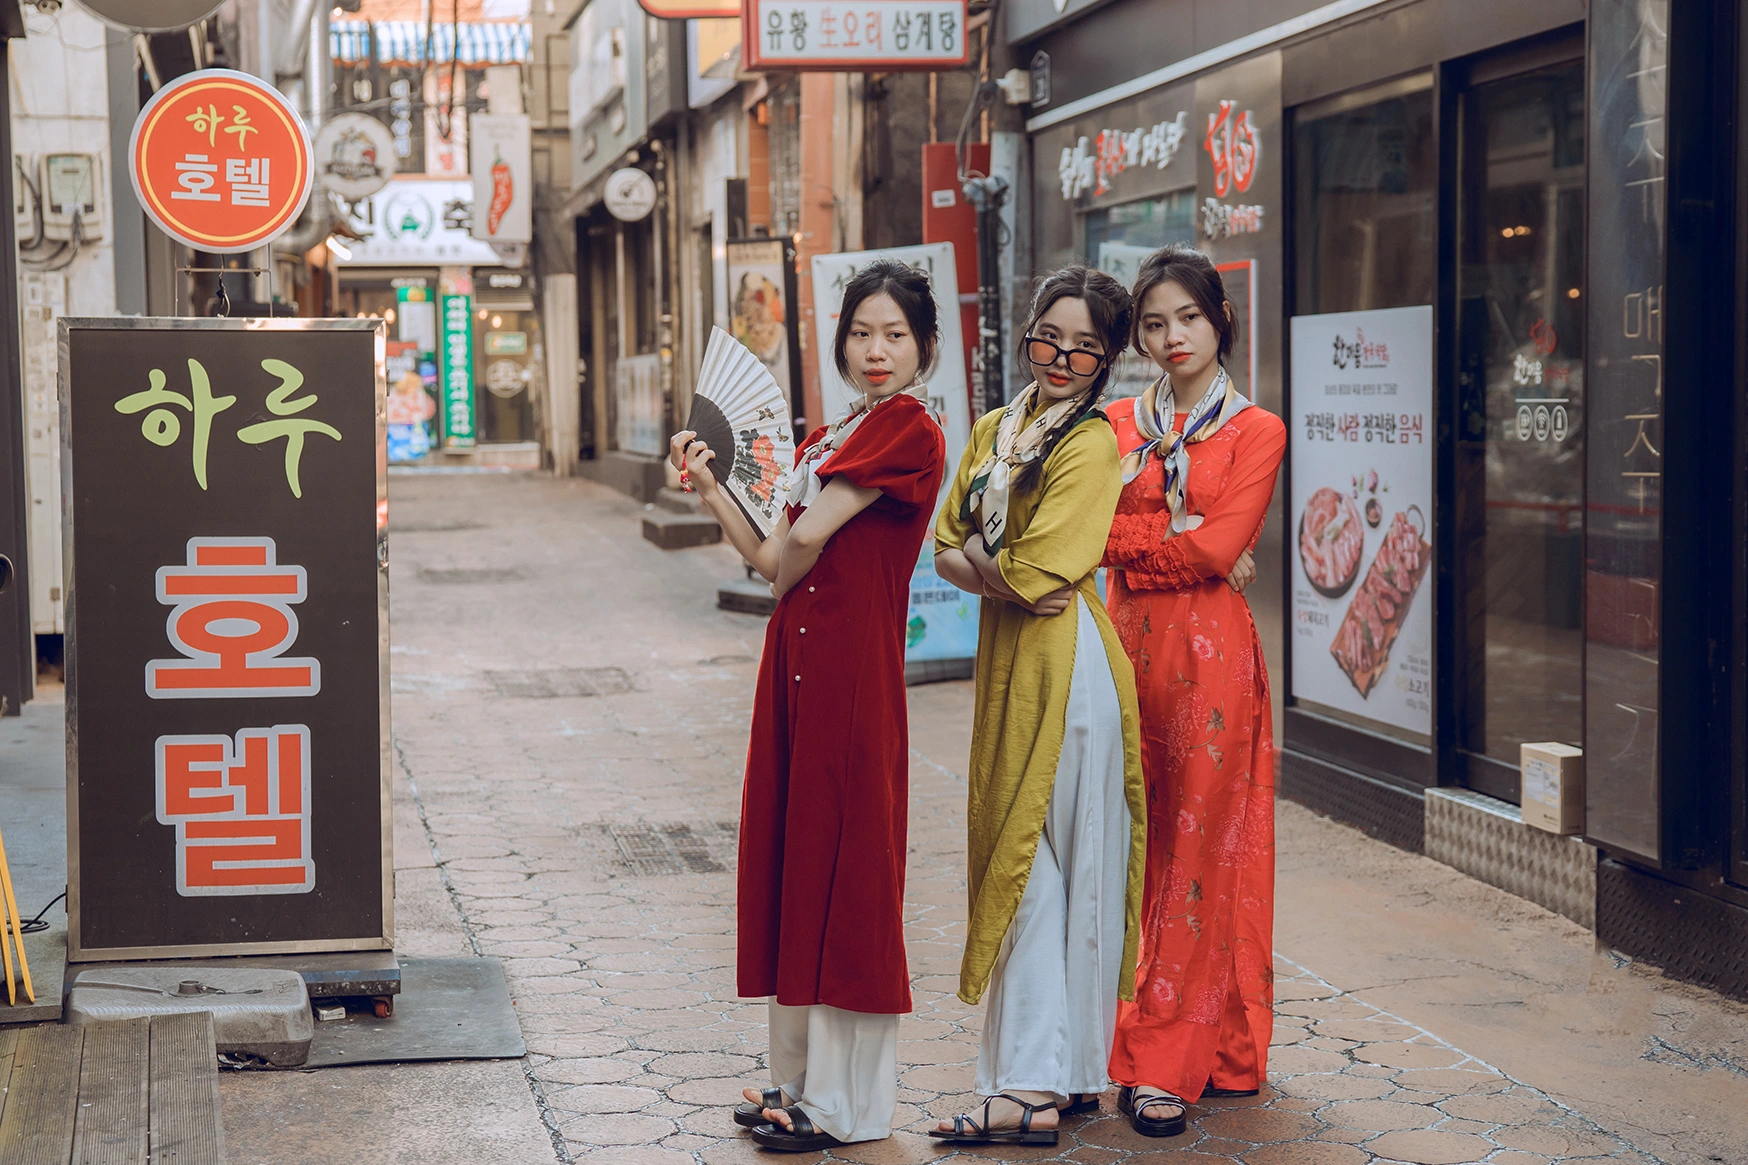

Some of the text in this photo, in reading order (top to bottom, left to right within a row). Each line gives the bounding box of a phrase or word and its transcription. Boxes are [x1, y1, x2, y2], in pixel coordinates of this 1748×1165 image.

[767, 10, 808, 51] 유황
[892, 11, 957, 52] 삼계탕
[185, 103, 259, 152] 하루
[170, 153, 270, 207] 호텔
[1621, 283, 1664, 516] 맥주
[114, 358, 342, 498] 하루
[1304, 412, 1423, 444] 정직한 사람 정직한 음식
[145, 536, 321, 897] 호텔
